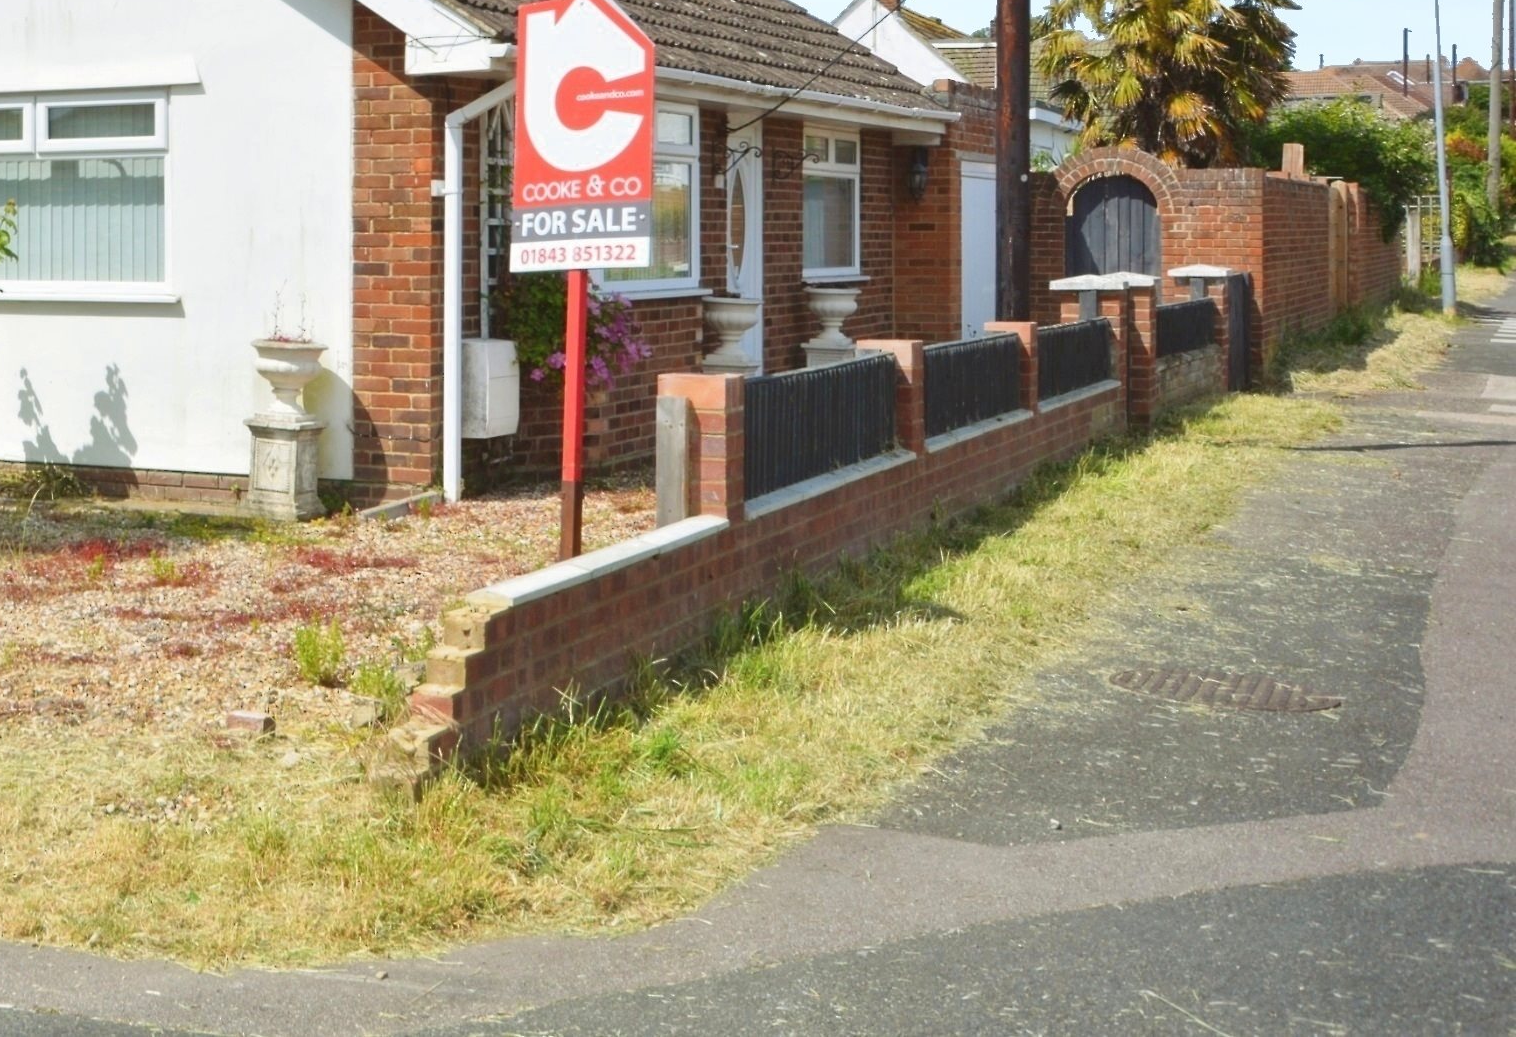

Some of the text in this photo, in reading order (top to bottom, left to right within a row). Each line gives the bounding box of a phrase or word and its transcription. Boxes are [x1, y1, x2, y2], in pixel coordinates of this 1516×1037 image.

[522, 174, 642, 202] COOKE & CO
[521, 206, 637, 237] FOR SALE
[521, 244, 636, 265] 01843 851322
